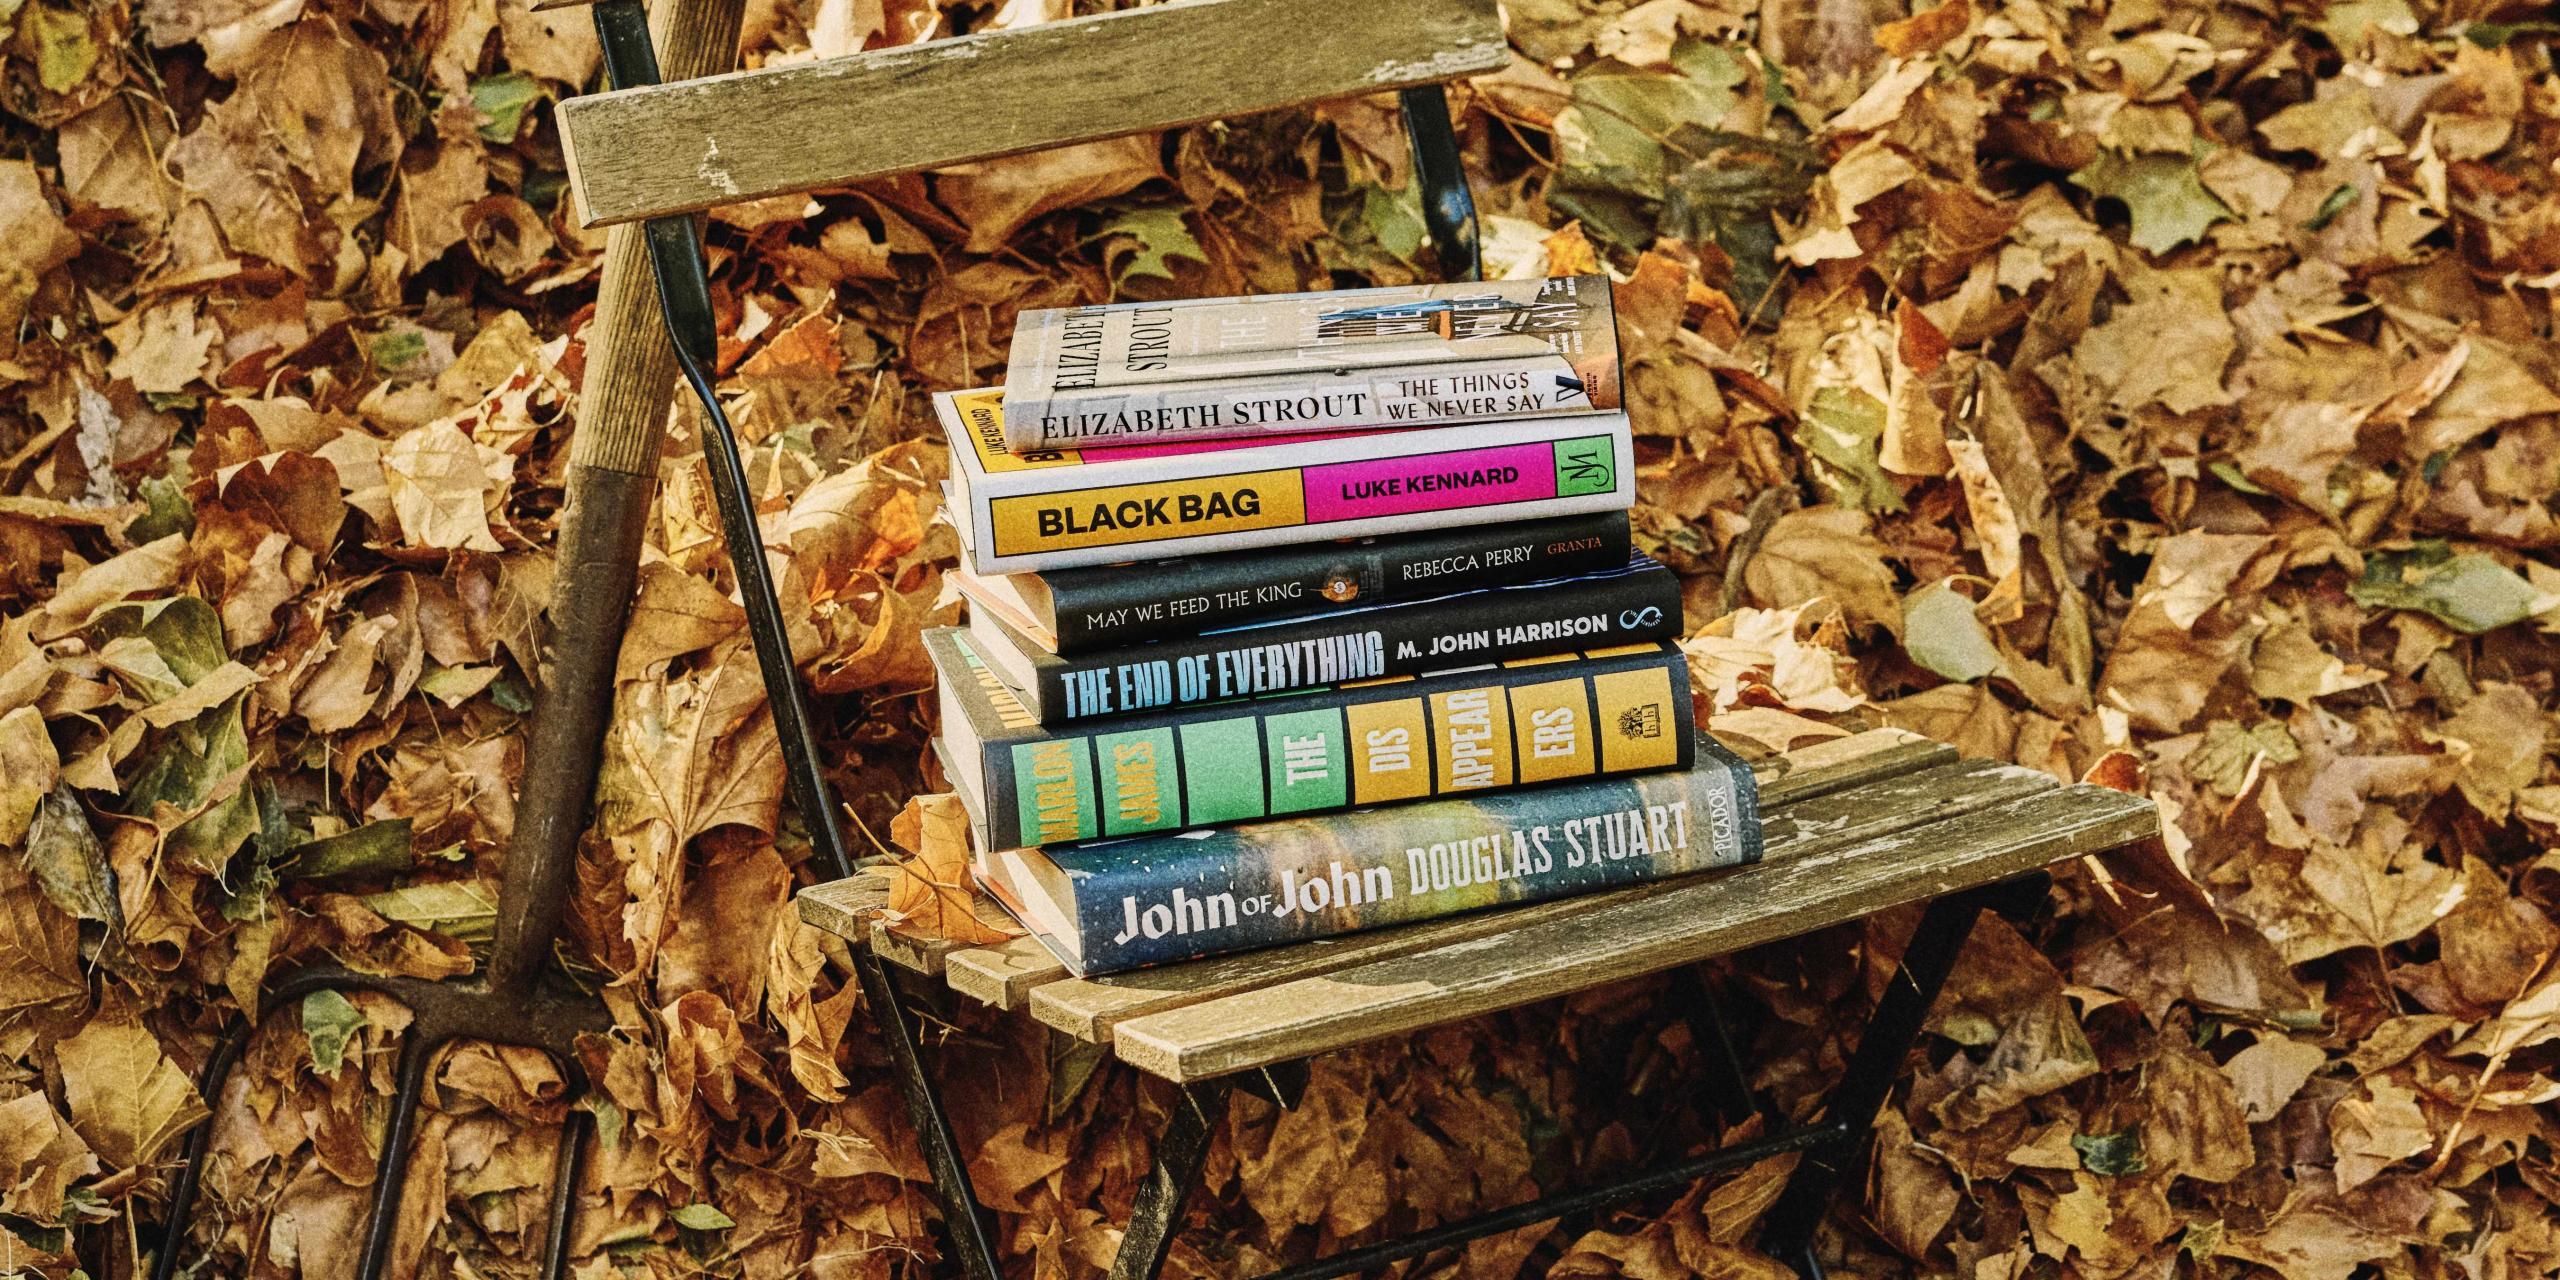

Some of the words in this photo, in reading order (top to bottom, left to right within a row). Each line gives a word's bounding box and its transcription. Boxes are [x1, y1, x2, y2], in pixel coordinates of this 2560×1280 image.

[1126, 307, 1173, 371] STROUT
[1376, 309, 1421, 336] WE
[1453, 292, 1501, 342] NEVER
[1532, 302, 1580, 327] SAY
[1386, 402, 1418, 420] WE
[1427, 397, 1498, 418] NEVER
[1506, 393, 1545, 412] SAY
[1398, 378, 1439, 398] THE
[1449, 371, 1530, 394] THINGS
[971, 408, 1002, 437] KENNARD
[1041, 403, 1220, 439] ELIZABETH
[1233, 393, 1367, 425] STROUT
[984, 437, 1009, 456] LUKE
[1342, 478, 1402, 501] LUKE
[1406, 466, 1519, 494] KENNARD
[1038, 496, 1171, 537] BLACK
[1178, 488, 1260, 523] BAG
[1402, 554, 1480, 580] REBECCA
[1486, 544, 1534, 567] PERRY
[1547, 536, 1602, 555] GRANTA
[1087, 609, 1129, 630] MAY
[1135, 603, 1163, 623] WE
[1170, 597, 1210, 617] FEED
[1216, 589, 1250, 610] THE
[1256, 581, 1302, 603] KING
[1397, 641, 1422, 660] M.
[1429, 630, 1489, 655] JOHN
[1496, 614, 1608, 646] HARRISON
[1060, 667, 1113, 719] THE
[1117, 660, 1172, 711] END
[1177, 654, 1211, 702] OF
[1216, 630, 1385, 697] EVERYTHING
[1366, 727, 1412, 773] DIS
[1447, 690, 1494, 787] APPEAR
[1531, 706, 1576, 759] ERS
[1114, 740, 1160, 824] JAMES
[1283, 732, 1328, 786] THE
[1031, 741, 1080, 843] MARLON
[1708, 786, 1732, 849] PICADOR
[1407, 825, 1553, 895] DOUGLAS
[1563, 801, 1688, 868] STUART
[1114, 887, 1237, 946] John
[1241, 894, 1271, 916] OF
[1272, 861, 1393, 918] John
